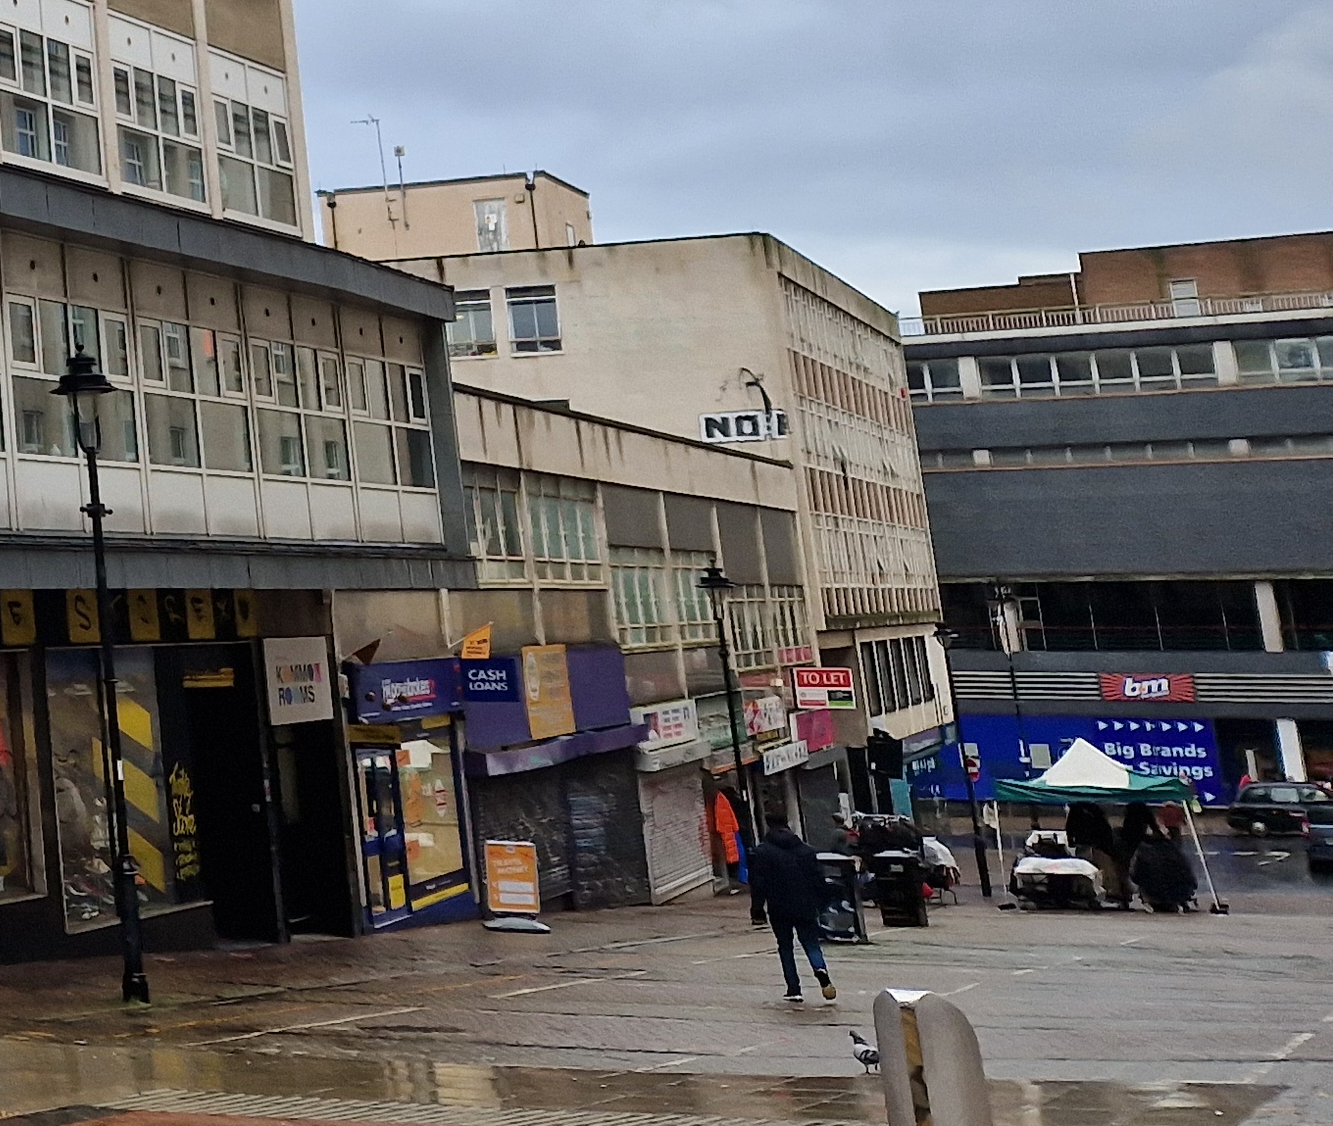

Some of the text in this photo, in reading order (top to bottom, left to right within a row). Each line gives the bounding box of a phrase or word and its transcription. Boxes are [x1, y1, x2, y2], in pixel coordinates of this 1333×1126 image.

[468, 669, 507, 681] CASH
[800, 672, 847, 685] TO LET
[469, 681, 508, 691] LOANS
[278, 684, 315, 706] ROOMS
[1103, 742, 1208, 760] Big Brands
[1139, 761, 1213, 780] Savings
